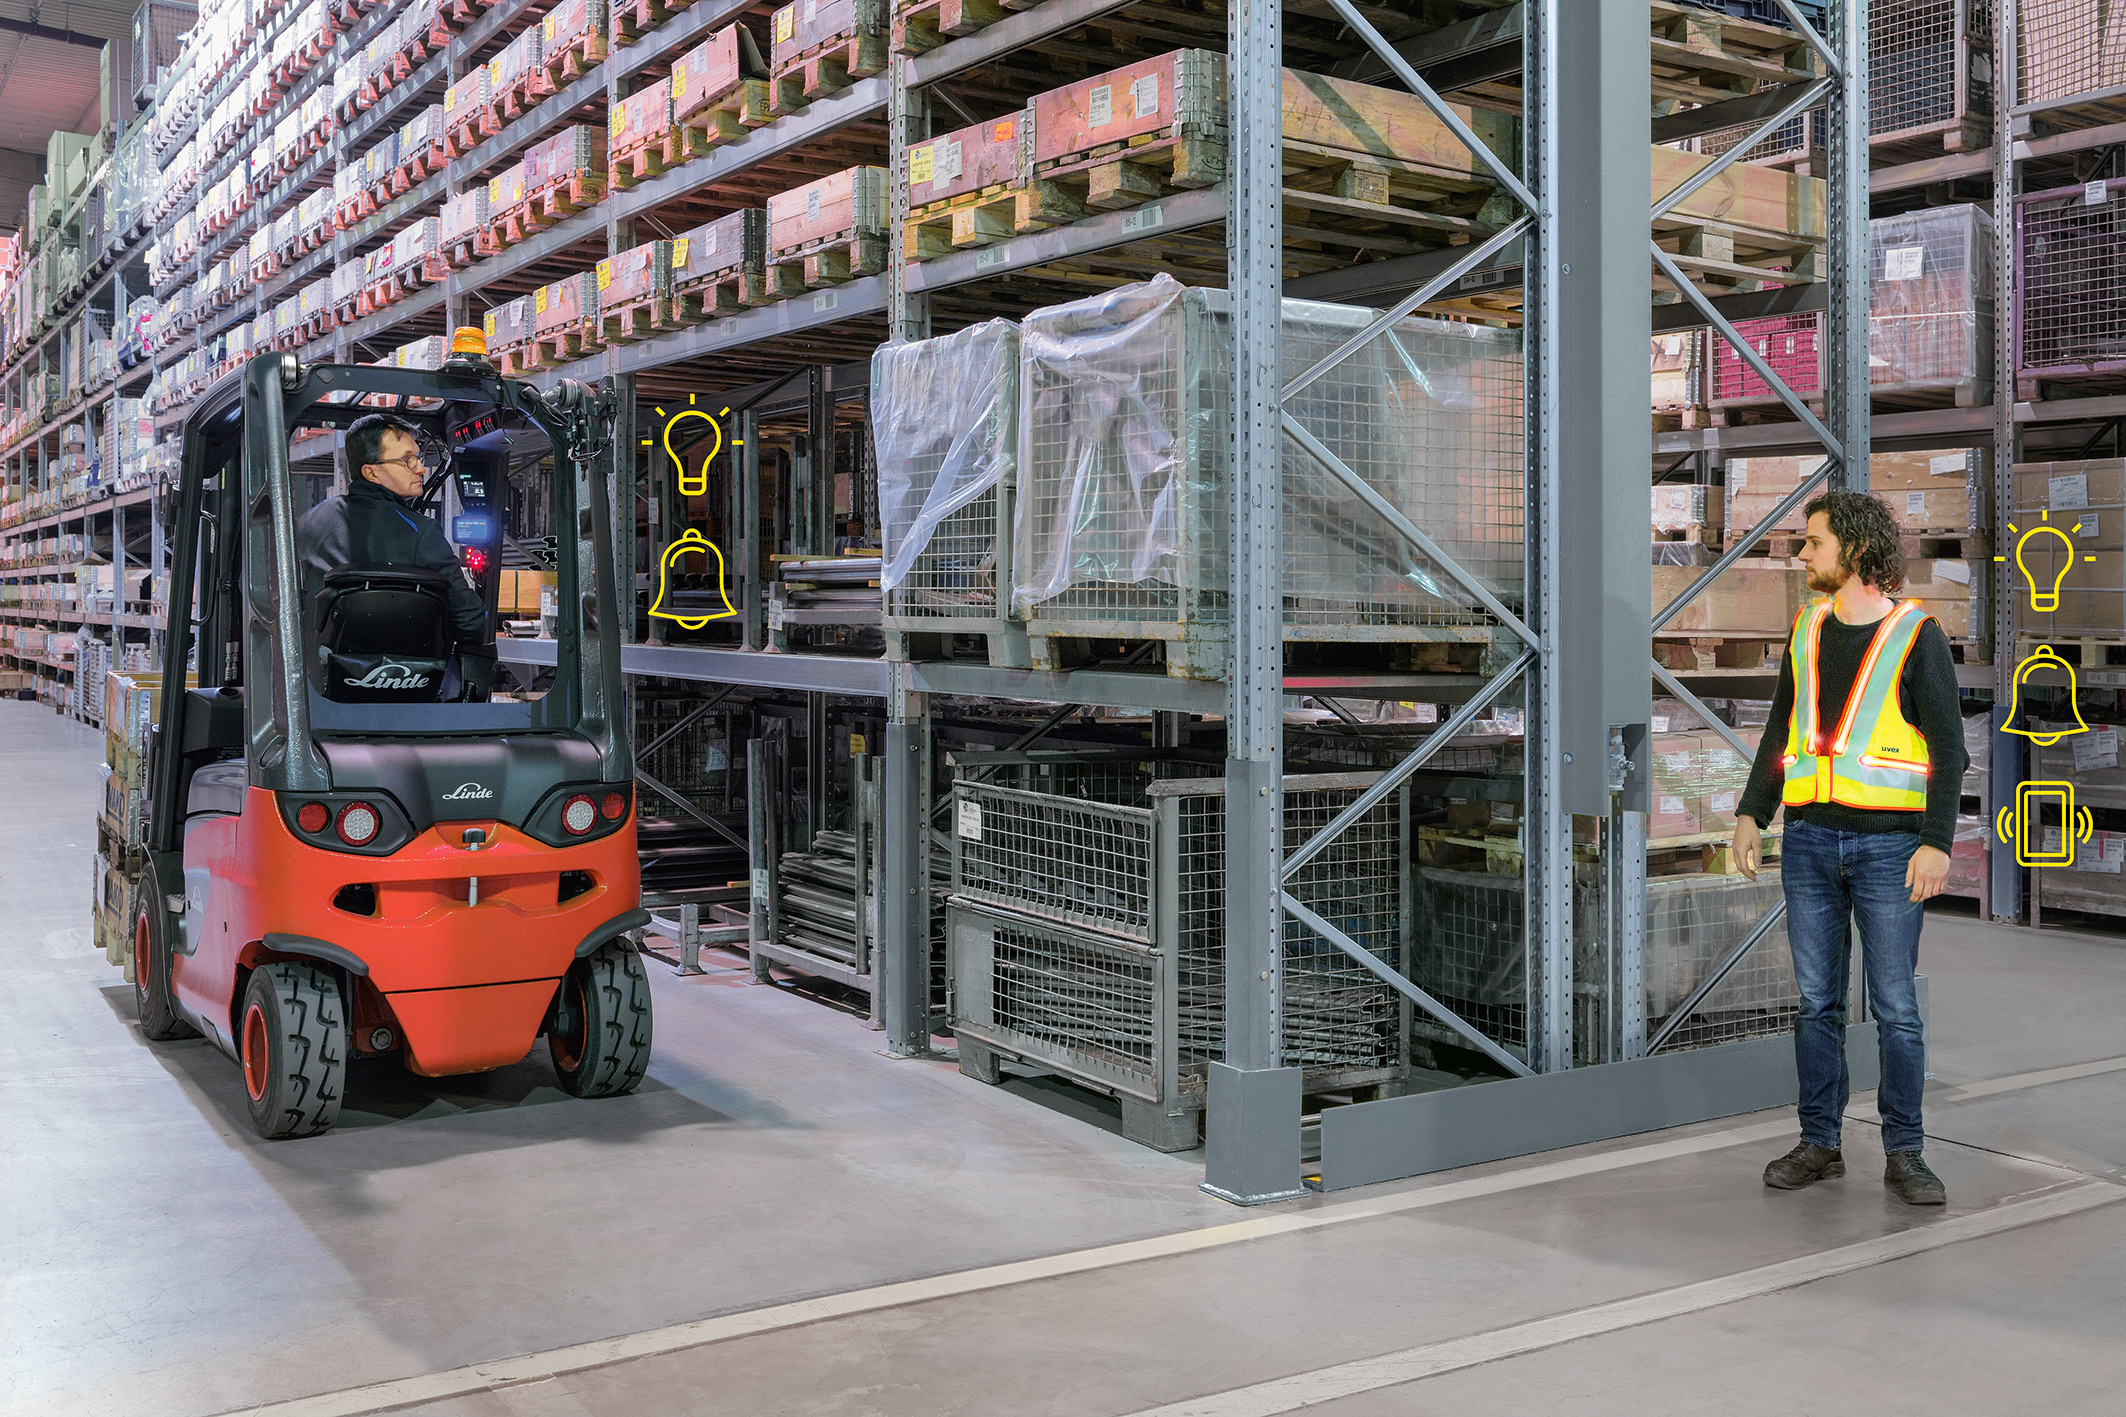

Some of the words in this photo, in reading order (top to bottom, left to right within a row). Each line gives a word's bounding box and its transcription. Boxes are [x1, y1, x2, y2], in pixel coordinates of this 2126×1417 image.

[343, 664, 430, 690] Linde
[1881, 746, 1900, 754] uvex
[442, 782, 494, 800] Linde
